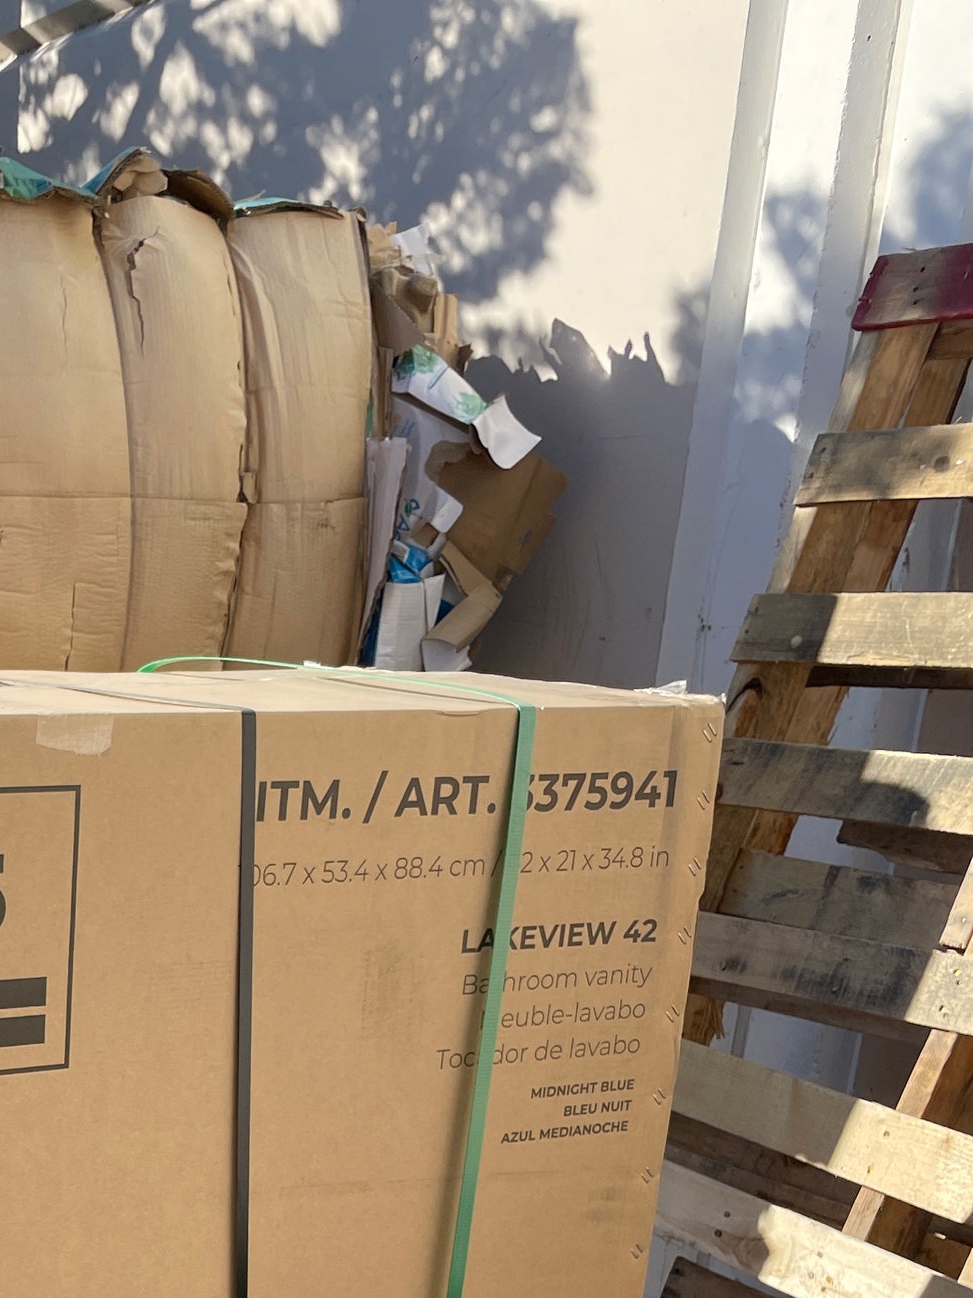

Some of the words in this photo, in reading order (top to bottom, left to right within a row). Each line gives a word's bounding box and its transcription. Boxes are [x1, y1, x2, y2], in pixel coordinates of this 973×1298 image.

[256, 779, 351, 822] ITM.
[362, 770, 389, 824] /
[394, 775, 496, 818] ART.
[302, 866, 316, 885] x
[321, 859, 369, 884] 53.4
[375, 863, 388, 881] x
[394, 856, 444, 880] 88.4
[449, 858, 485, 877] cm
[538, 856, 551, 873] x
[556, 850, 576, 872] 21
[581, 854, 595, 871] x
[598, 846, 644, 870] 34.8
[650, 845, 669, 868] in
[623, 919, 658, 943] 42
[462, 970, 578, 996] Bahroom
[585, 962, 653, 989] vanity
[480, 999, 646, 1031] euble-lavabo
[436, 1043, 528, 1070] Tocdor
[534, 1039, 562, 1061] de
[570, 1034, 641, 1058] lavabo
[530, 1082, 597, 1099] MIDNIGHT
[600, 1079, 635, 1092] BLUE
[563, 1103, 597, 1117] BLEU
[601, 1100, 632, 1113] NUIT
[500, 1131, 535, 1144] AZUL
[539, 1121, 628, 1140] MEDIANOCHE
